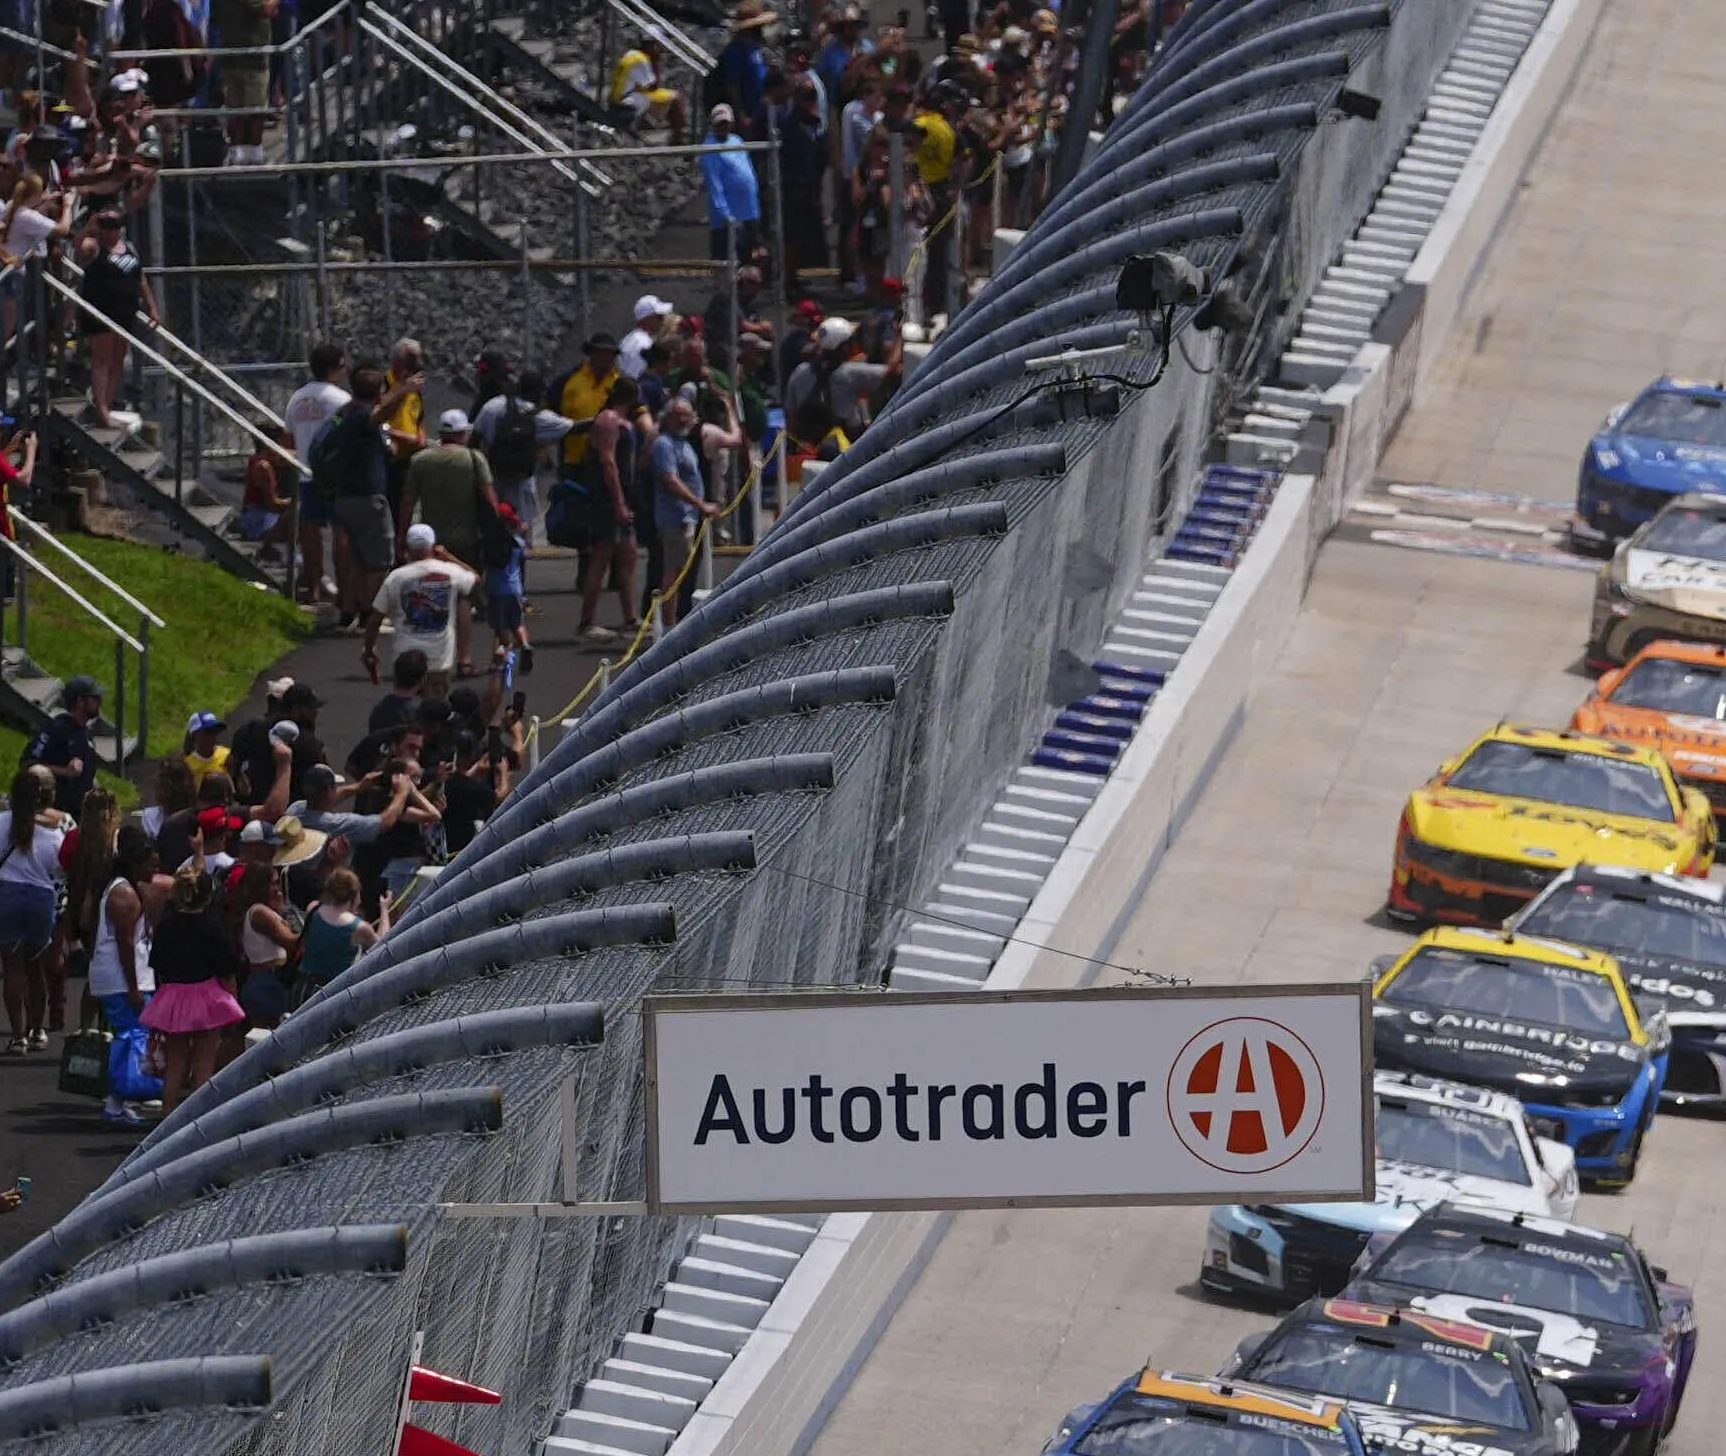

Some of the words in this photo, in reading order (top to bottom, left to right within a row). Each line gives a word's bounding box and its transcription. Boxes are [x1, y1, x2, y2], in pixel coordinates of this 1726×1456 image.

[693, 1063, 1147, 1146] Autotrader
[1524, 1243, 1614, 1268] BOWMAN
[1421, 1341, 1483, 1362] BERRY
